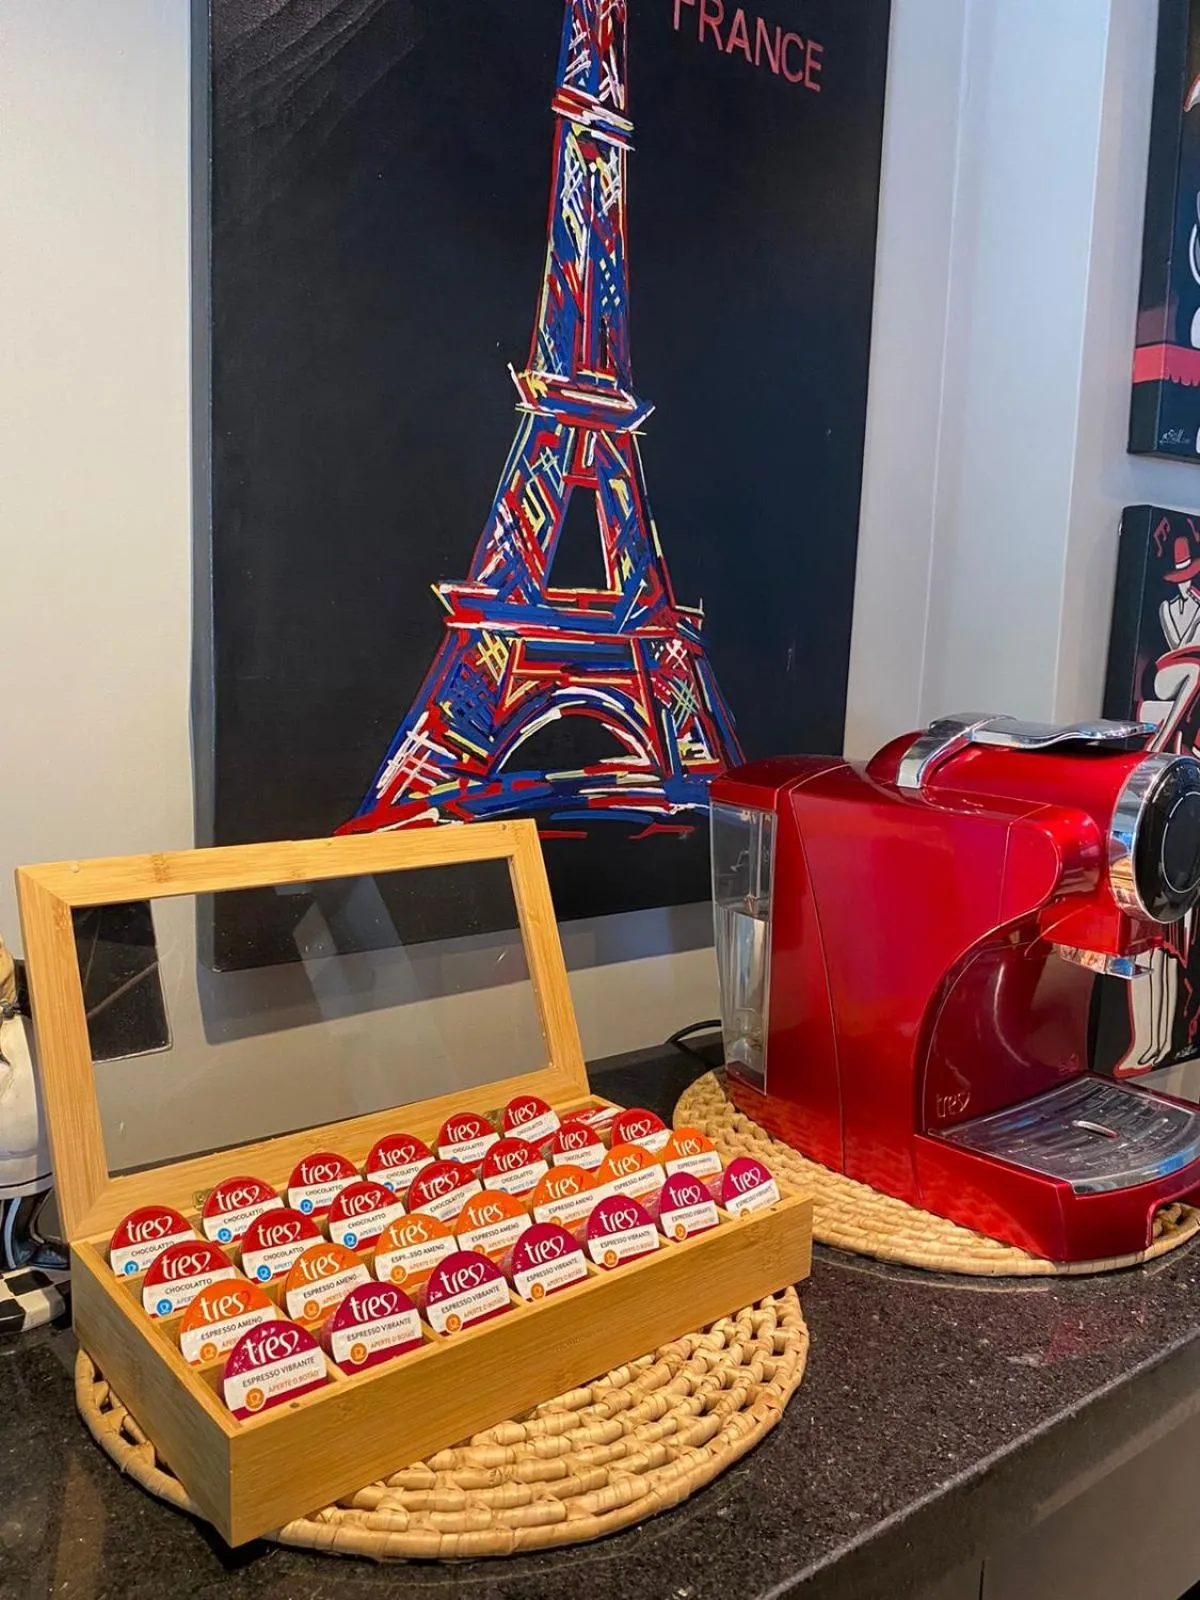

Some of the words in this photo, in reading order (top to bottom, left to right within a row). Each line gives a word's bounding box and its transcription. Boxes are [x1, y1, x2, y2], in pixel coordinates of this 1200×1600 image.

[673, 0, 823, 92] FRANCE
[508, 1102, 537, 1126] tres
[447, 1121, 480, 1143] tres
[559, 1130, 588, 1151] tres
[620, 1119, 651, 1141] tres
[378, 1145, 415, 1167] tres
[673, 1137, 703, 1157] tres
[300, 1161, 341, 1184] tres
[386, 1166, 420, 1178] CHOCOLATTO
[493, 1149, 528, 1172] tres
[609, 1153, 643, 1177] tres
[305, 1184, 343, 1196] CHOCOLATTO
[419, 1170, 459, 1200] tres
[546, 1176, 581, 1199] tres
[730, 1167, 761, 1193] tres
[216, 1185, 260, 1211] tres
[340, 1190, 381, 1217] tres
[429, 1191, 465, 1212] CHOCOLATTO
[669, 1185, 701, 1207] tres
[223, 1207, 265, 1224] CHOCOLATTO
[347, 1212, 386, 1229] CHOCOLATTO
[468, 1203, 505, 1227] tres
[599, 1207, 639, 1232] tres
[126, 1215, 173, 1243] tres
[258, 1221, 301, 1247] tres
[389, 1220, 429, 1247] tres
[131, 1240, 174, 1257] CHOCOLATTO
[263, 1246, 305, 1261] CHOCOLATTO
[423, 1243, 445, 1254] AMENO
[524, 1235, 564, 1264] tres
[162, 1251, 211, 1280] tres
[300, 1252, 343, 1280] tres
[526, 1267, 554, 1282] ESPRESSO
[165, 1278, 213, 1295] CHOCOLATTO
[303, 1282, 335, 1299] ESPRESSO
[336, 1273, 357, 1287] AMENO
[440, 1262, 485, 1295] tres
[200, 1290, 251, 1322] tres
[349, 1291, 398, 1322] tres
[441, 1296, 472, 1314] ESPRESSO
[472, 1284, 500, 1301] VIBRANTE
[201, 1324, 237, 1340] ESPRESSO
[237, 1315, 263, 1329] AMENO
[346, 1326, 380, 1342] ESPRESSO
[380, 1316, 412, 1331] VIBRANTE
[240, 1330, 299, 1365] tres
[242, 1368, 280, 1388] ESPRESSO
[280, 1356, 315, 1373] VIBRANTE
[268, 1379, 292, 1393] APERTE
